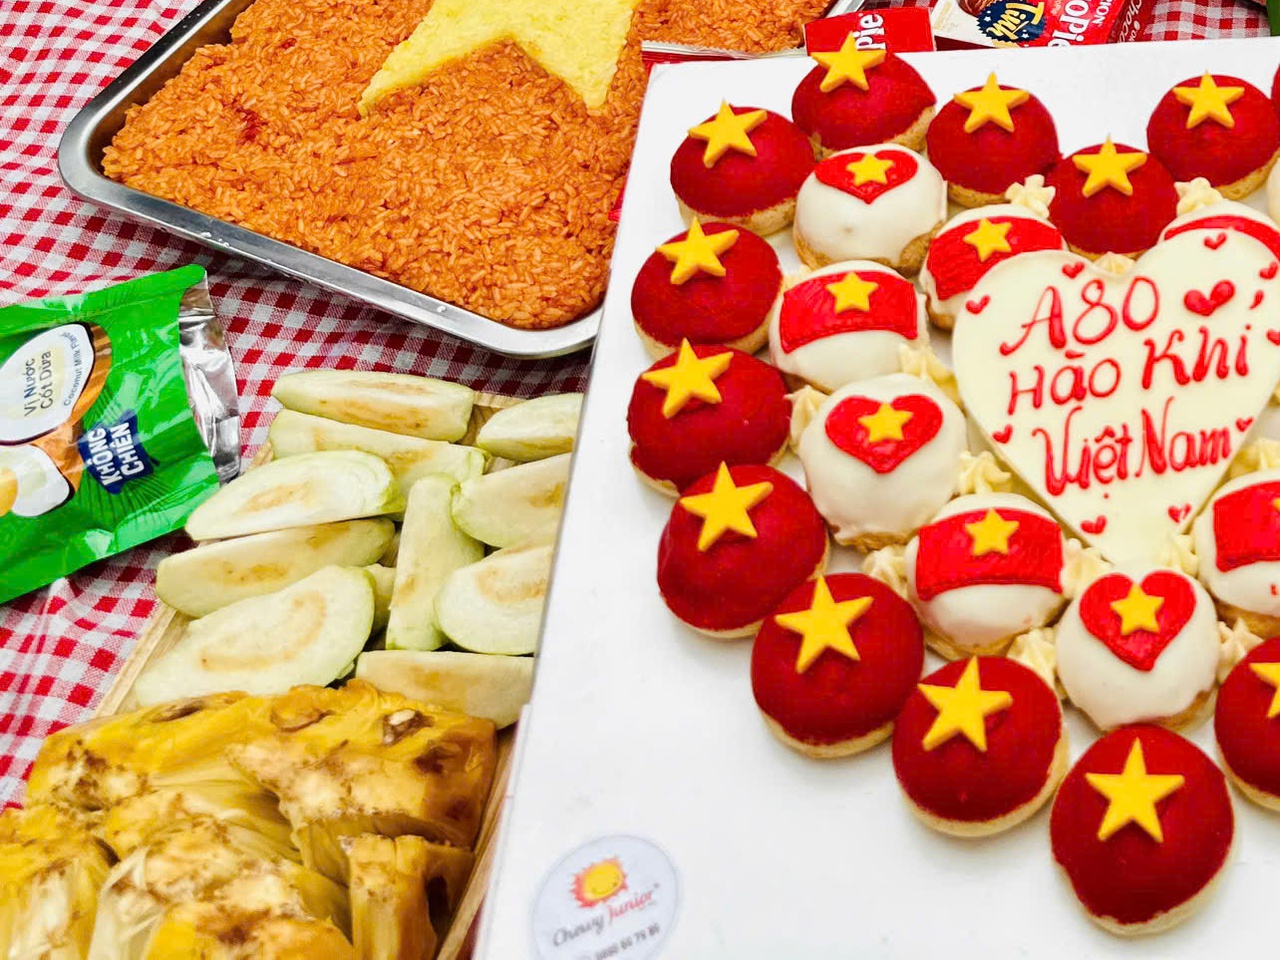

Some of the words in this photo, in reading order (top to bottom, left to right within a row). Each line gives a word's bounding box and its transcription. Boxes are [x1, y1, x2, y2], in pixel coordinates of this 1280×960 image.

[1000, 276, 1160, 356] A80
[23, 357, 36, 398] Nước
[40, 350, 53, 381] Dừa
[63, 367, 83, 407] Coconut
[73, 350, 83, 367] Milk
[24, 397, 41, 418] Vị
[40, 381, 54, 410] Cốt
[86, 427, 124, 486] KHÔNG
[108, 421, 146, 477] CHIÊN
[1032, 405, 1133, 500] Việt
[1134, 396, 1231, 478] Nam
